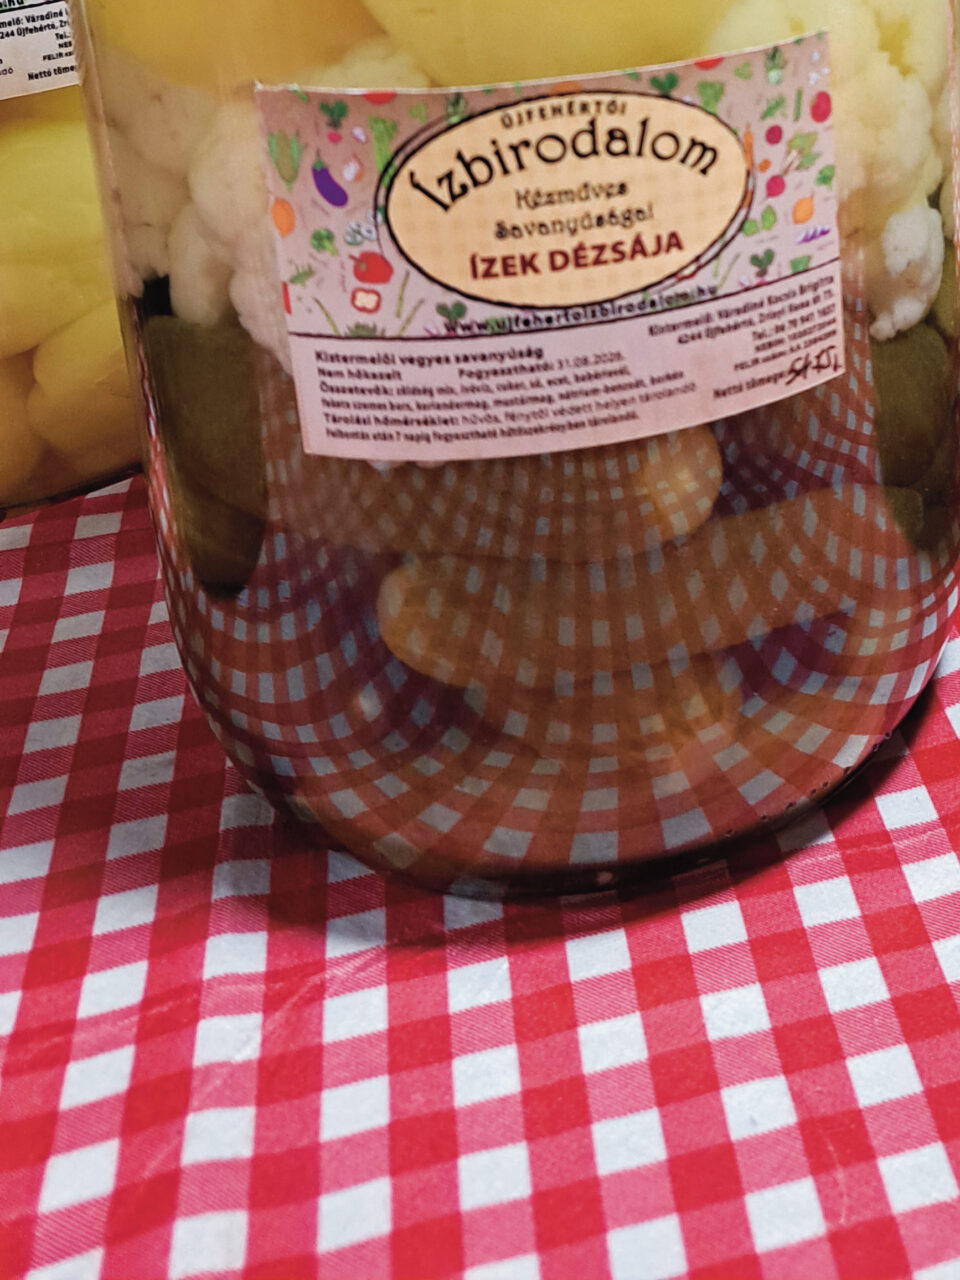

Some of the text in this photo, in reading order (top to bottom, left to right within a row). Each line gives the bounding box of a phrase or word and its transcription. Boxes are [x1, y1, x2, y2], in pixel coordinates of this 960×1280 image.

[501, 100, 628, 129] ÚJFEHÉRTÓI
[409, 117, 719, 212] Ízbirodalom
[515, 179, 629, 210] Kézműves
[495, 204, 654, 240] Savanyúságai
[470, 231, 684, 279] ÍZEK DÉZSÁJA
